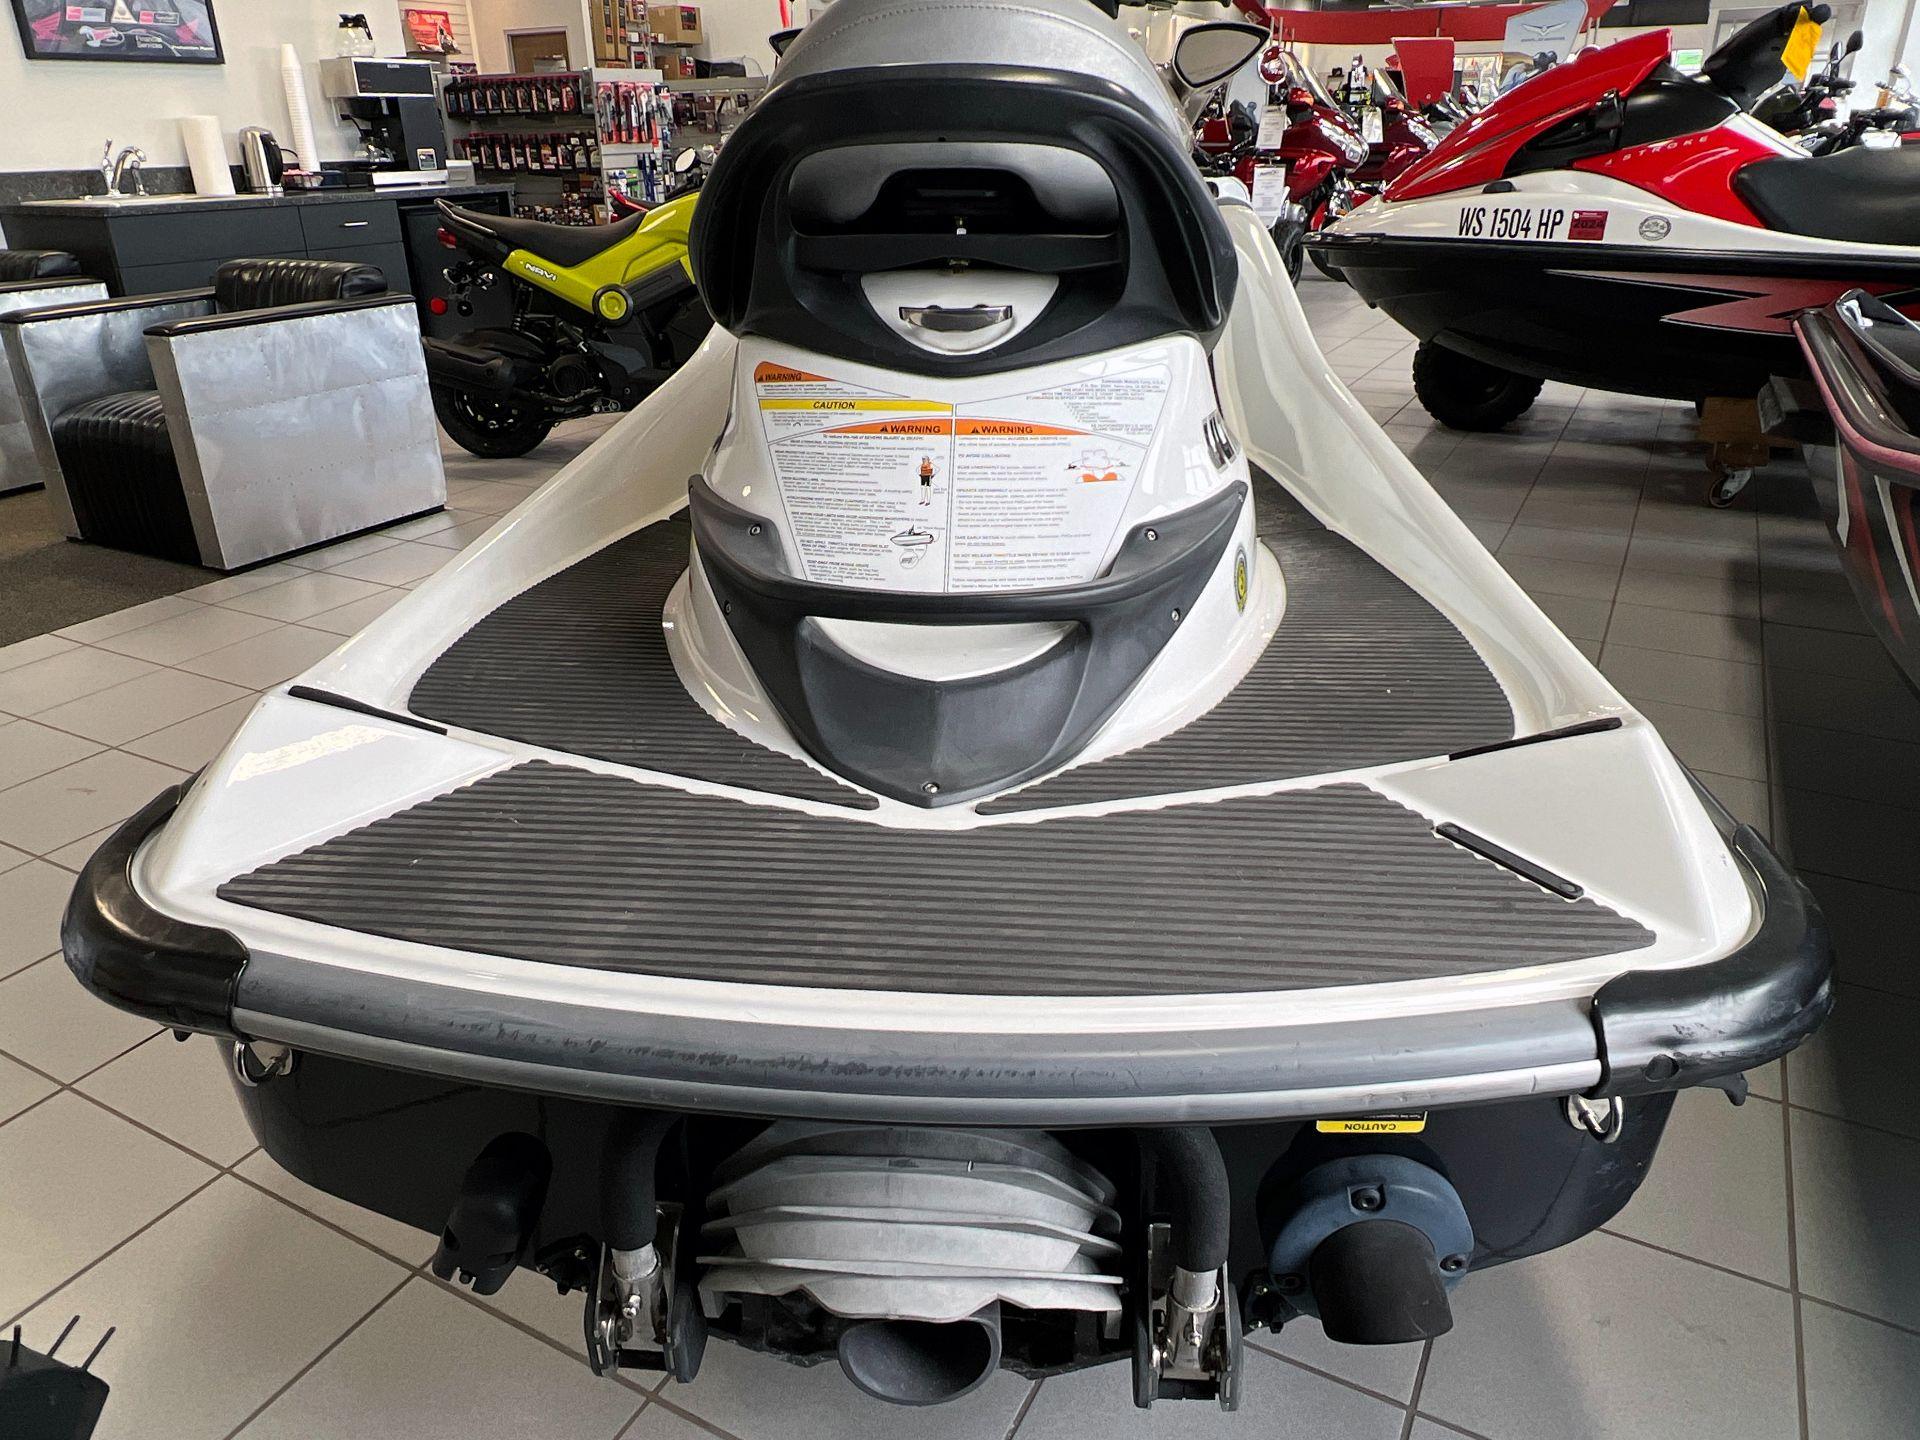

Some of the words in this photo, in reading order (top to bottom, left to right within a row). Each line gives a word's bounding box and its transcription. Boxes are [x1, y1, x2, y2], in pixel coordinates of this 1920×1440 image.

[1622, 135, 1709, 161] STROKE
[1459, 207, 1487, 237] WS
[1489, 207, 1533, 239] 1504
[1536, 208, 1565, 240] HP
[525, 262, 557, 281] NAVI
[766, 372, 802, 381] WARNING
[813, 401, 856, 410] CAUTION
[890, 424, 941, 434] WARNING
[981, 425, 1034, 434] WARNING
[1344, 1123, 1396, 1131] CAUTION
